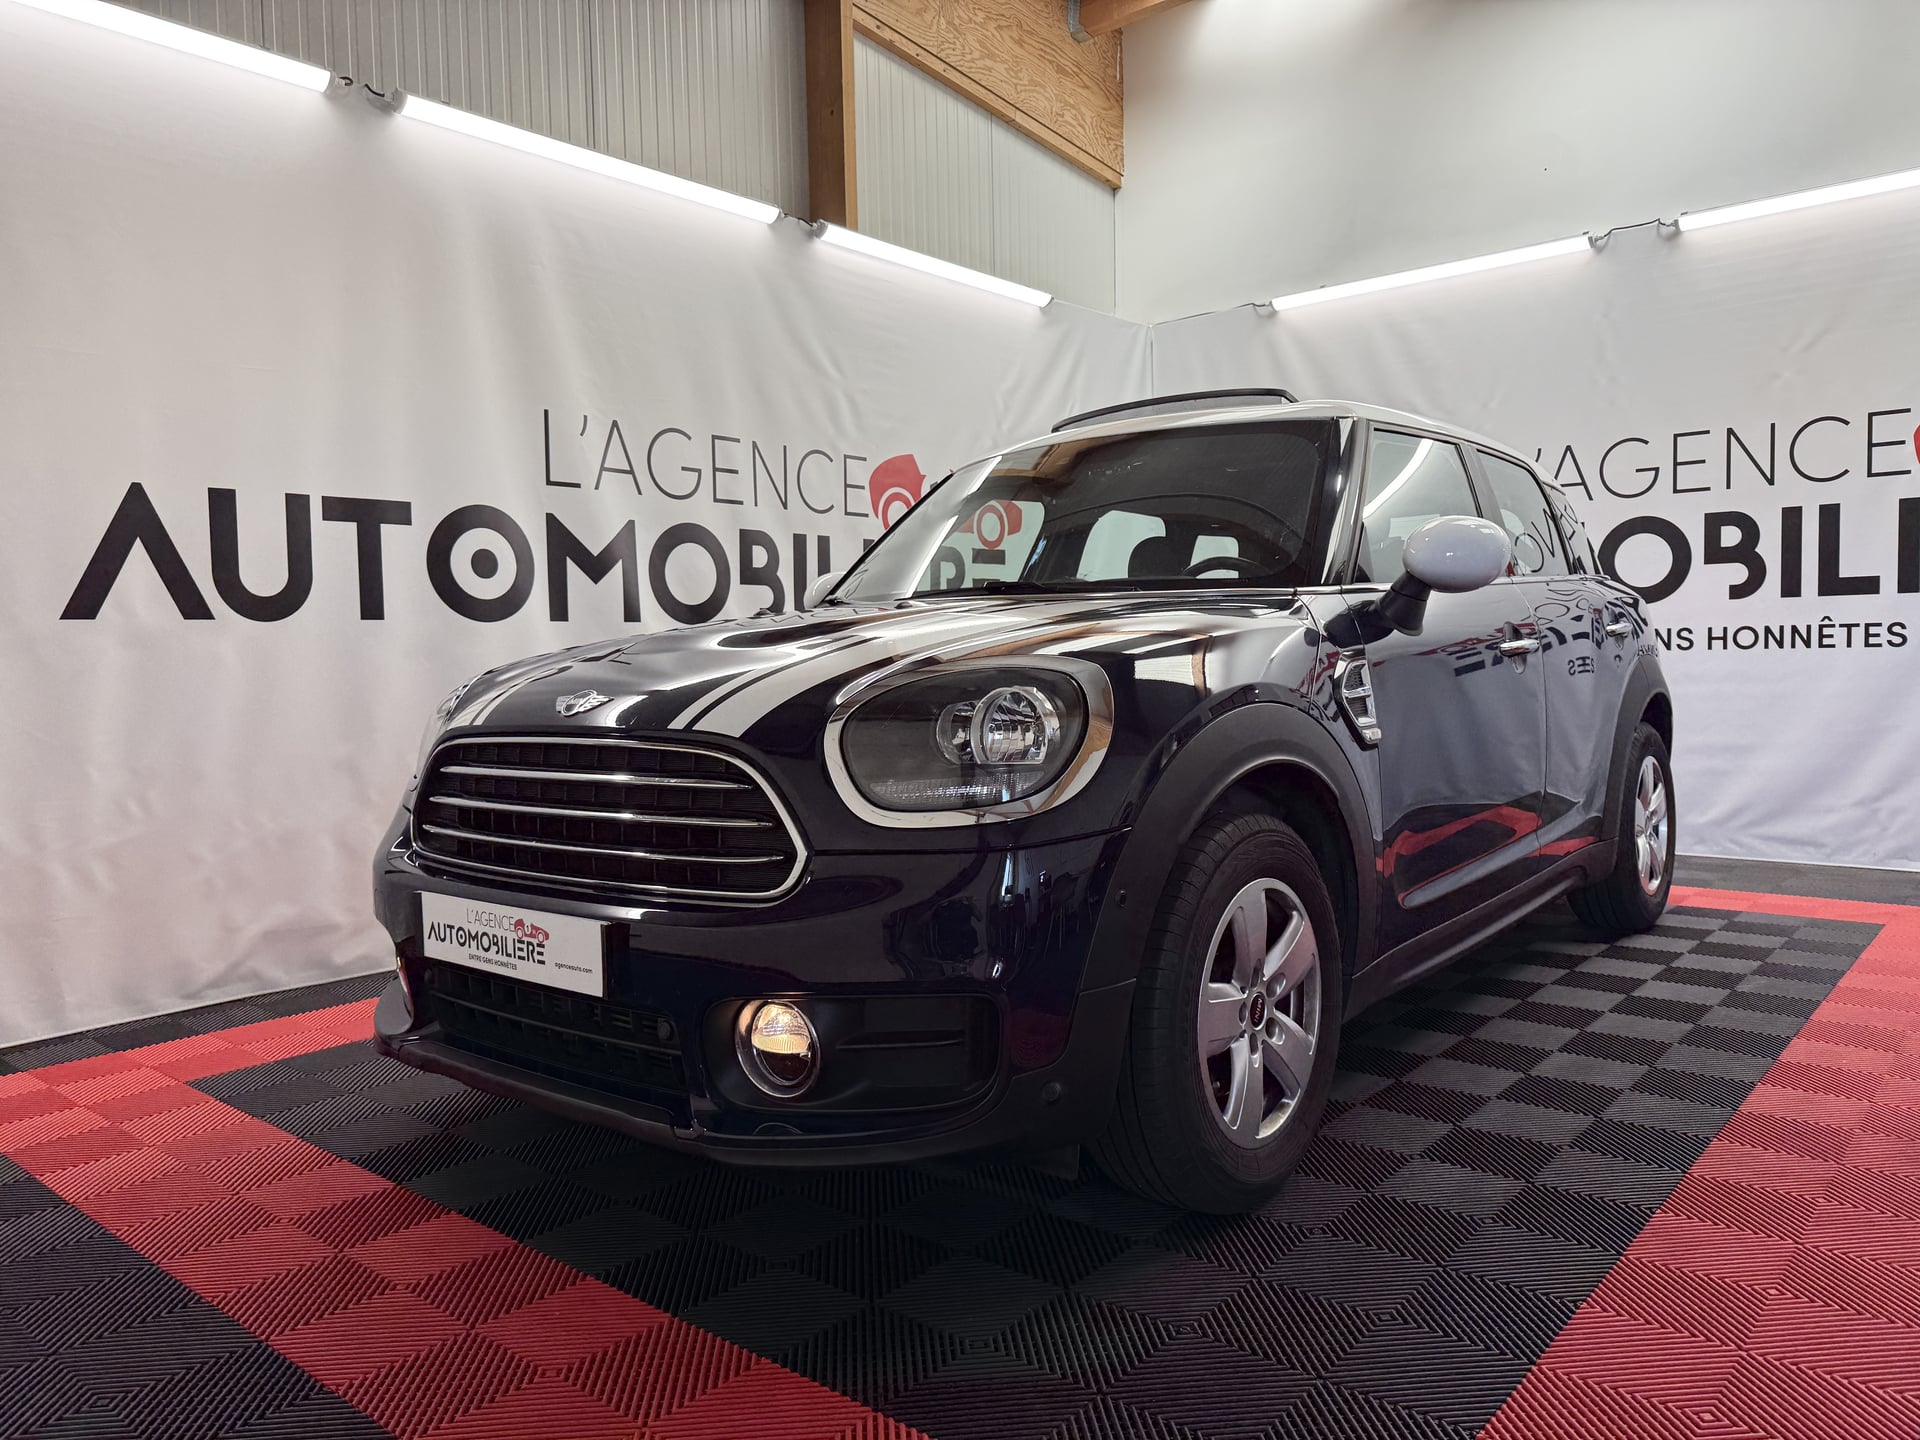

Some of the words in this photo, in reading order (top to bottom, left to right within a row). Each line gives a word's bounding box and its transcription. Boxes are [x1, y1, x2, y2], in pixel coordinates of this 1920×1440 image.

[544, 409, 869, 518] L'AGENCE
[1534, 408, 1911, 501] 'AGENCE
[1596, 497, 1920, 605] OBILI
[1654, 627, 1695, 651] NS
[1707, 615, 1909, 651] HONNÊTES
[466, 908, 515, 933] L'AGENCE
